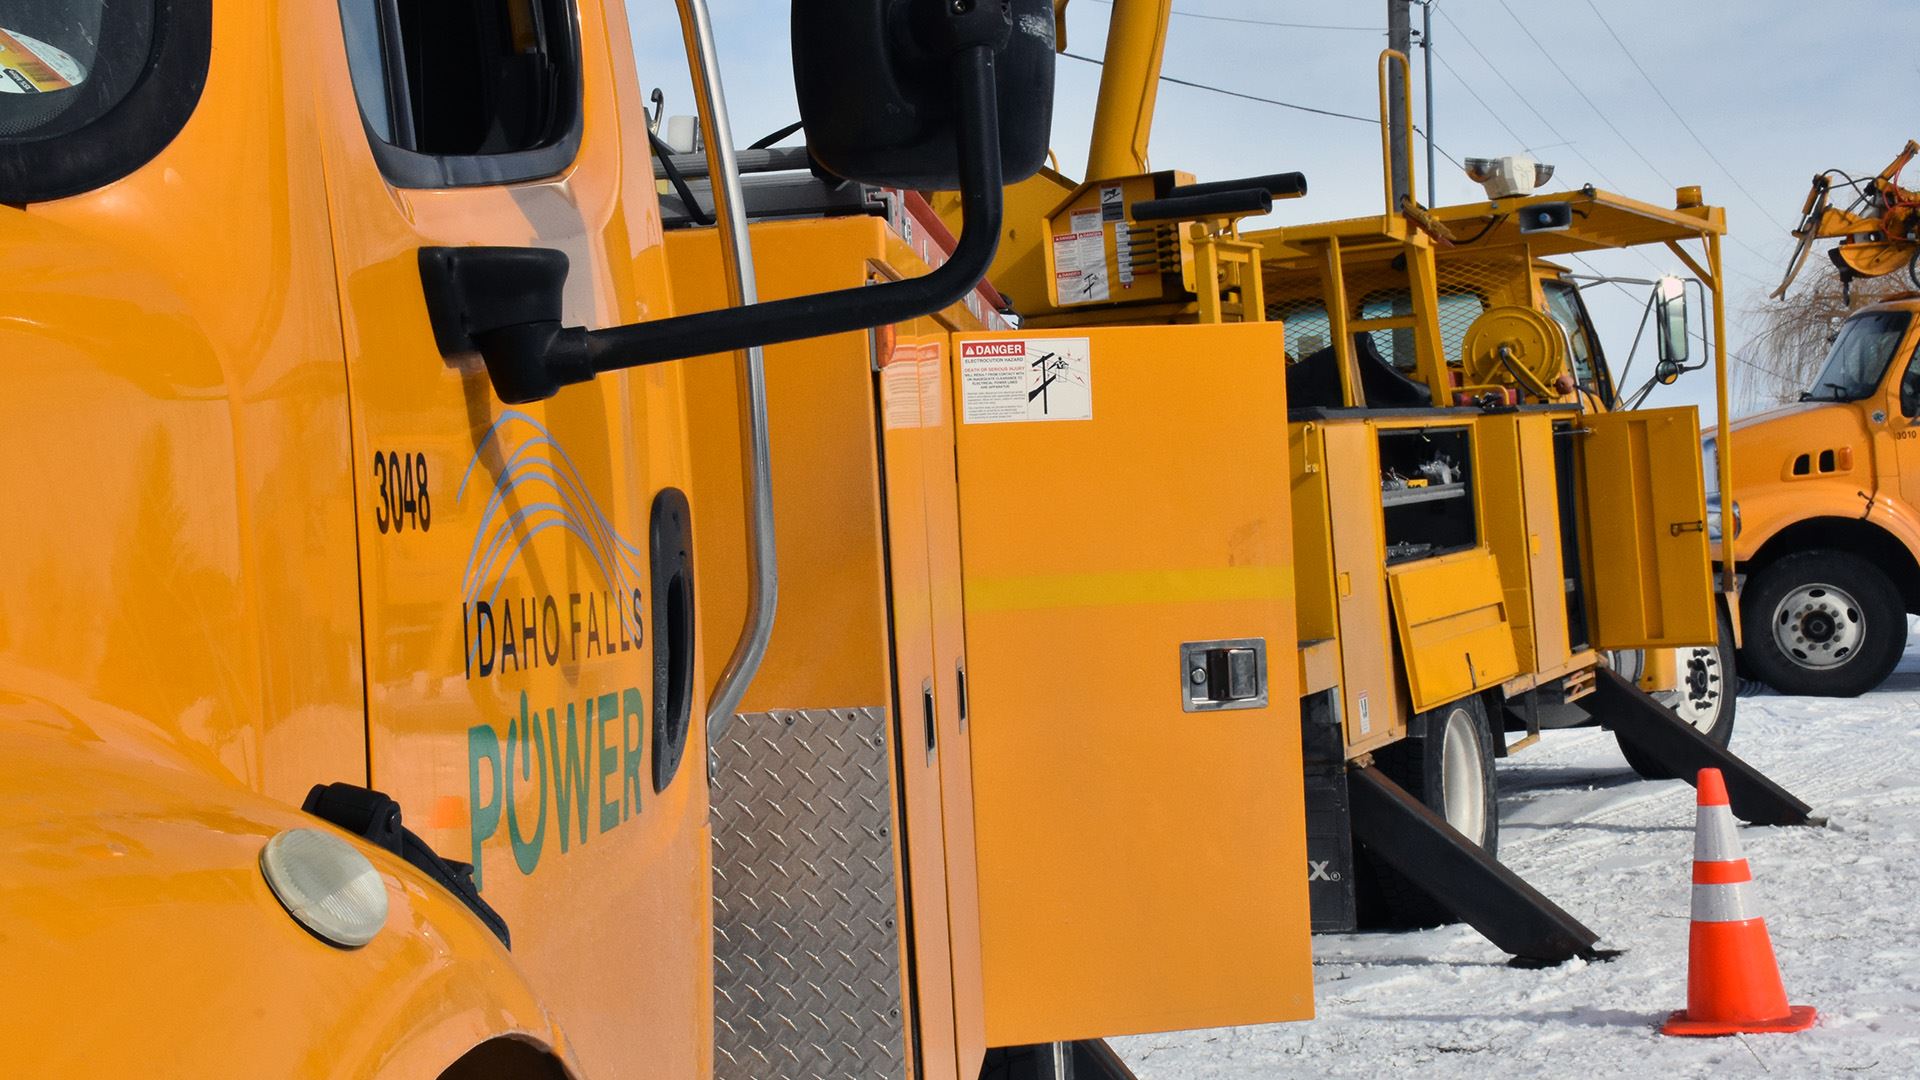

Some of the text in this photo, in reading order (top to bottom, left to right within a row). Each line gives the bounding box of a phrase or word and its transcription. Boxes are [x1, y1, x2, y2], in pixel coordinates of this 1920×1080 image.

[976, 344, 1022, 355] DANGER
[374, 450, 431, 535] 3048
[463, 587, 643, 680] IDAHO FALLS
[468, 687, 644, 893] POWER
